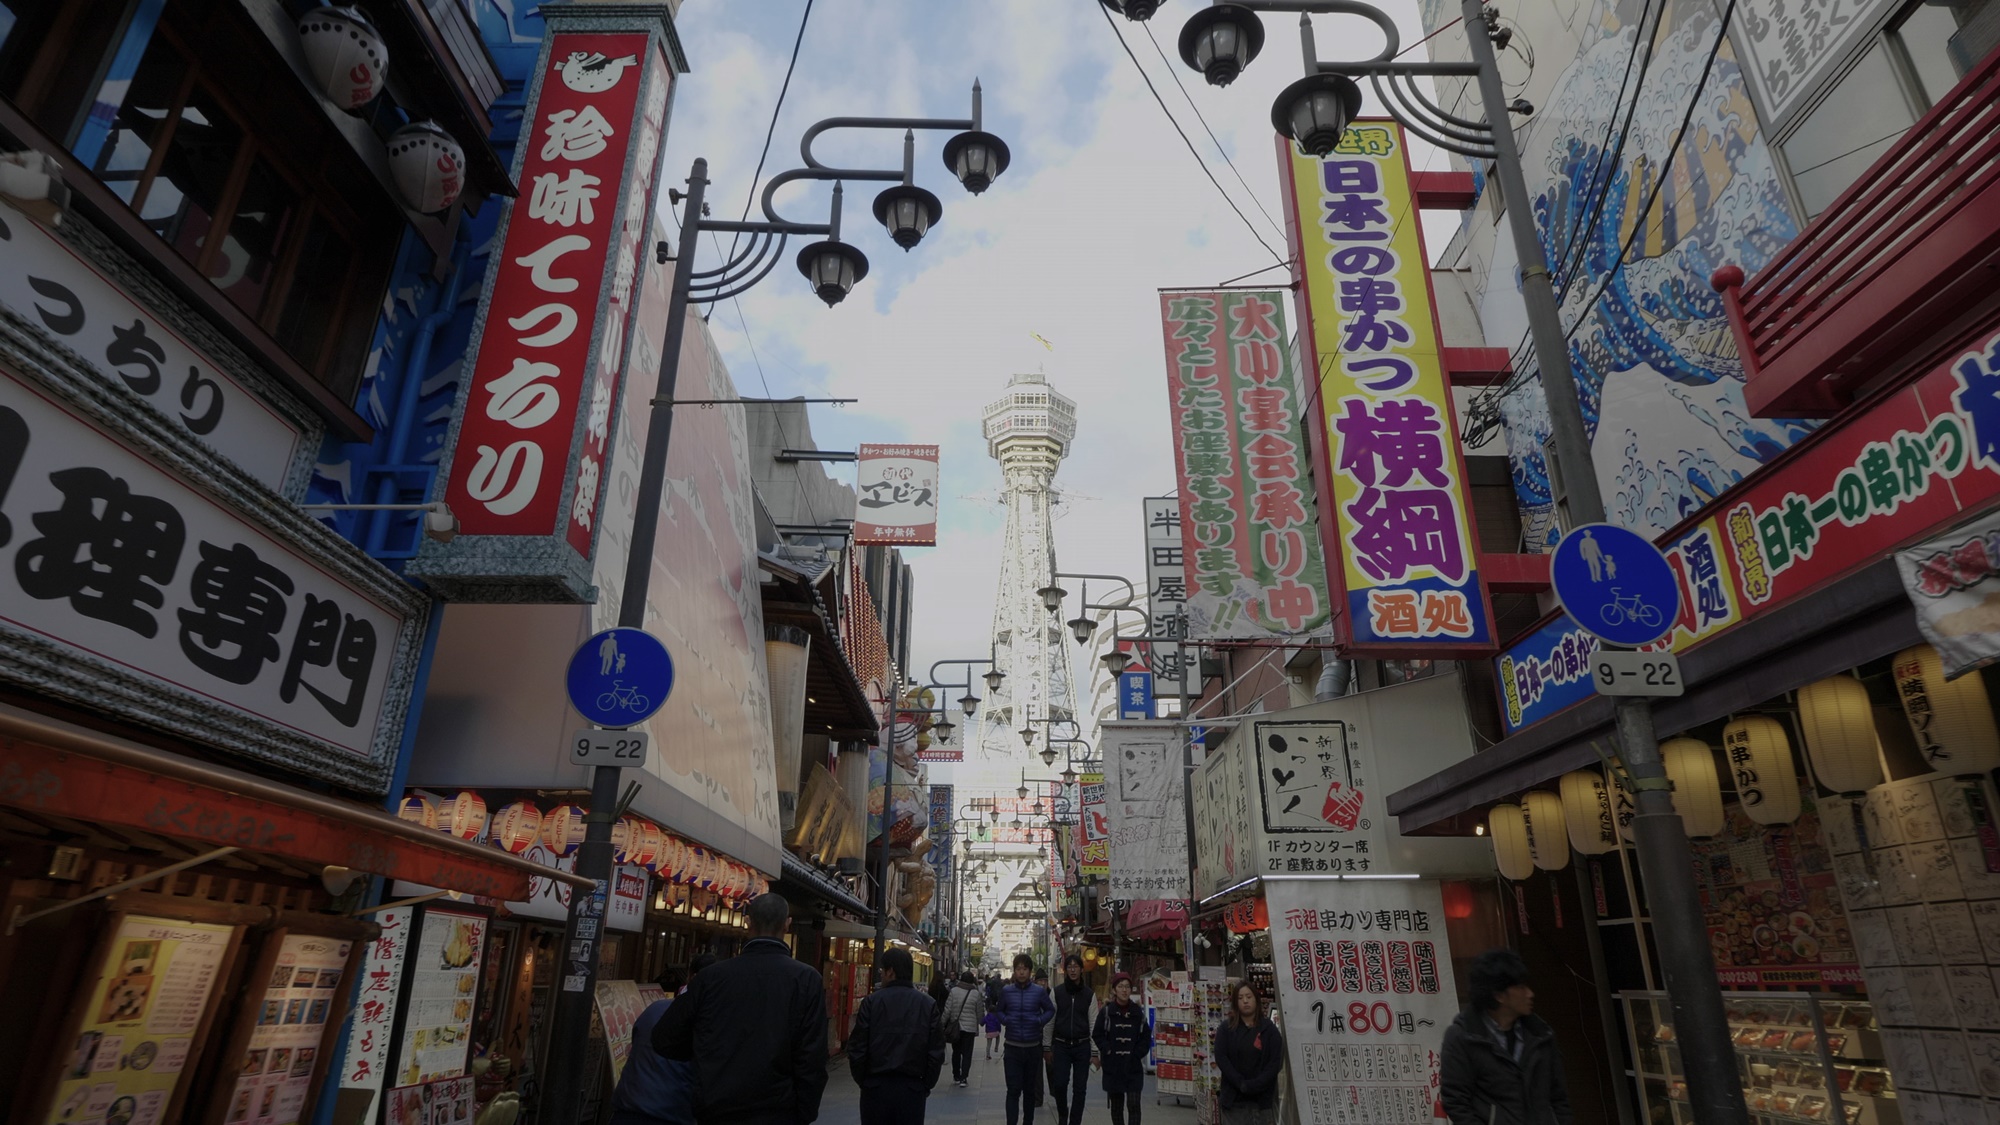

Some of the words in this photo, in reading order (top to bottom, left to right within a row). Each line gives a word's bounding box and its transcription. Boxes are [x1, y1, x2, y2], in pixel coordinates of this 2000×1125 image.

[1298, 127, 1393, 156] 世界
[1323, 160, 1414, 392] 日本一の串かつ
[1335, 398, 1465, 583] 横綱
[1757, 419, 1963, 573] 日本一の串かつ
[874, 527, 916, 538] 年中無休
[1731, 506, 1769, 601] 新世界
[1684, 533, 1729, 627] 酒処
[1372, 593, 1470, 635] 酒処
[1129, 676, 1145, 706] 喫茶
[1501, 658, 1522, 723] 新世界
[1598, 662, 1677, 686] 9-22
[576, 738, 643, 761] 9-22
[1731, 746, 1763, 806] 串かつ
[1083, 842, 1108, 861] 大
[1268, 840, 1281, 853] 1F
[1285, 840, 1369, 853] カウンター席
[1268, 858, 1282, 871] 2F
[1287, 857, 1371, 872] 座敷あります
[1112, 876, 1186, 889] 宴会予約受付中
[1284, 909, 1431, 931] 元祖串カツ専門店
[1291, 941, 1314, 990] 大阪名物
[1315, 942, 1337, 991] 串カツ
[1391, 942, 1412, 992] たこ焼き
[1415, 942, 1439, 993] 味自慢
